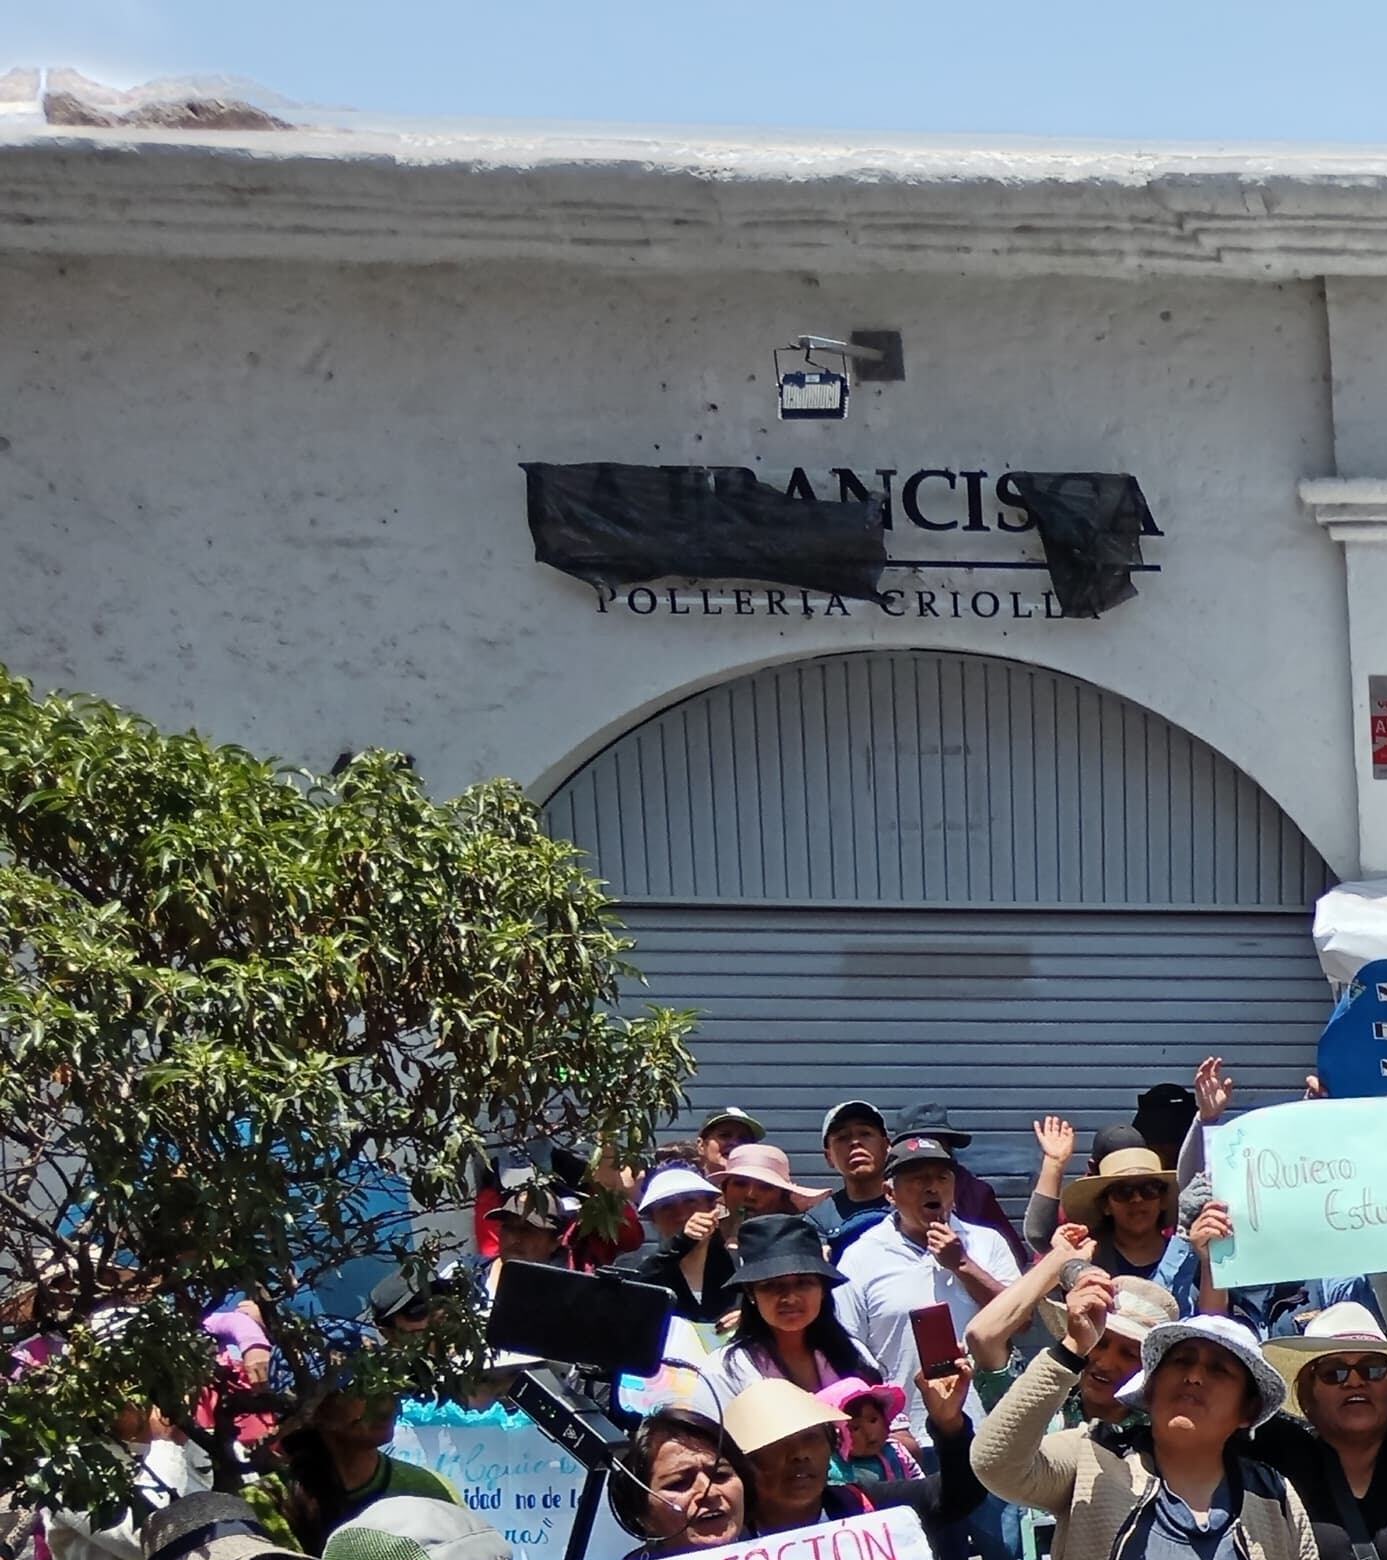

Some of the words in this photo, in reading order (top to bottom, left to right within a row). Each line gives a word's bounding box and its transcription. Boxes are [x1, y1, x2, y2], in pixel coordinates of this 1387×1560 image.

[881, 586, 1101, 619] CRIOLL
[515, 1493, 536, 1510] no
[542, 1486, 561, 1509] de
